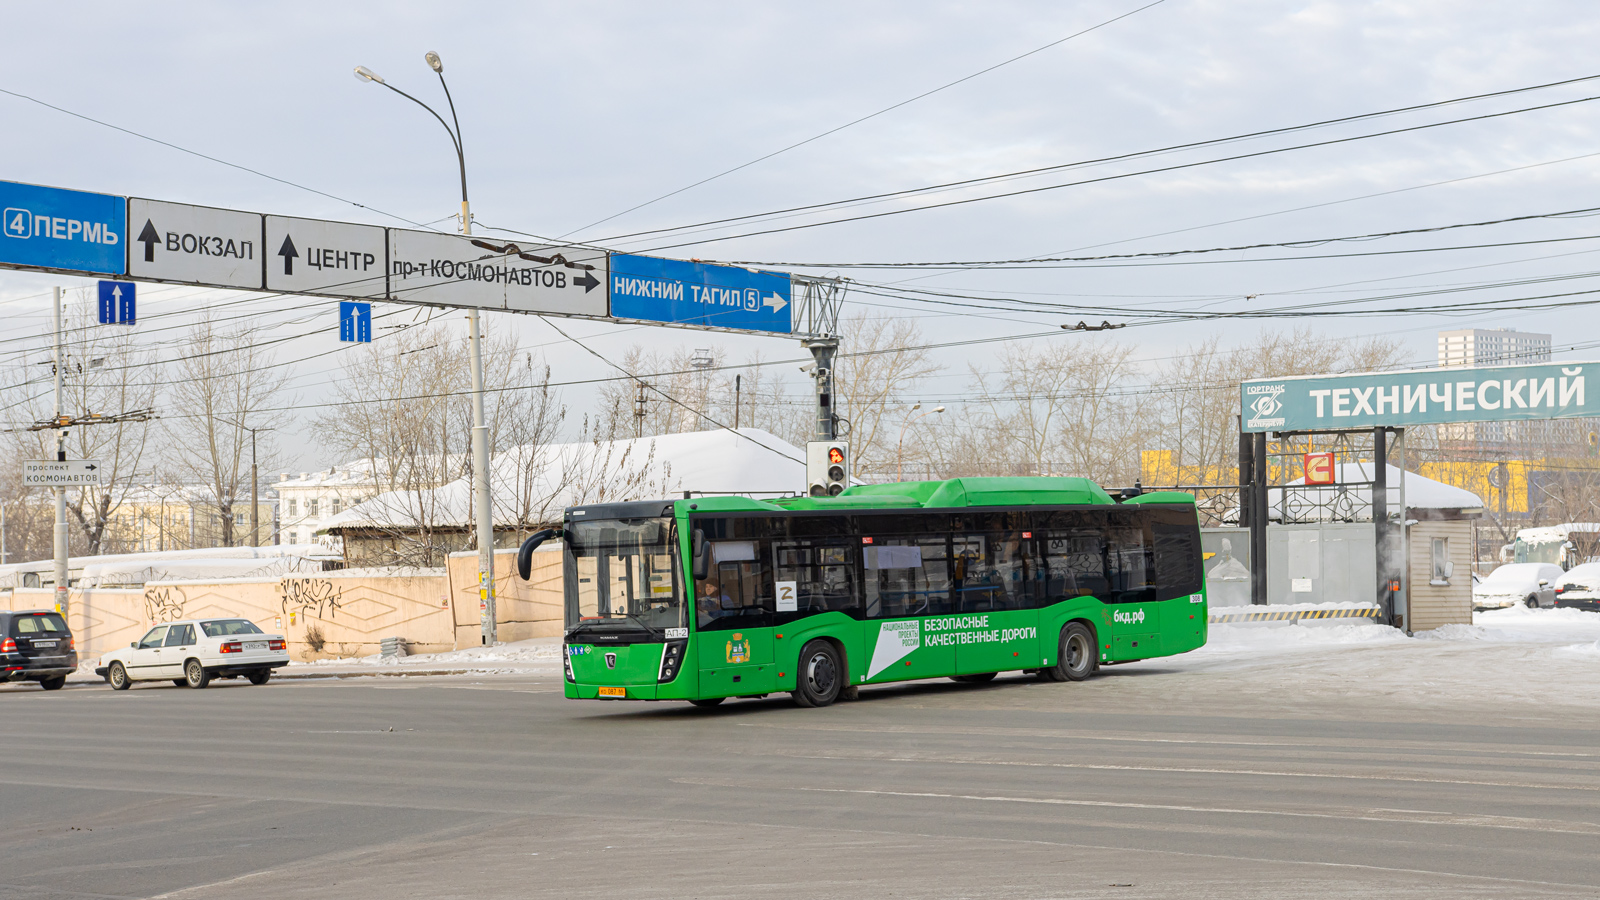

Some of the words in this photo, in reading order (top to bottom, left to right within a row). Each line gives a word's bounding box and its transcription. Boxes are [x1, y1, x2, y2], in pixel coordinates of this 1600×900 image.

[9, 213, 26, 236] 4
[34, 215, 119, 246] ПЕРМЬ
[165, 231, 254, 261] ВОКЗАЛ
[307, 247, 376, 272] ЦЕНТР
[392, 259, 427, 277] пр-т
[430, 258, 567, 289] КОСМОНАВТОВ
[614, 276, 685, 302] НИЖНИЙ
[690, 284, 742, 308] ТАГИЛ
[1247, 384, 1286, 395] ГОРТРАНС
[1309, 366, 1586, 418] ТЕХНИЧЕСКИЙ
[27, 464, 70, 472] проспект
[26, 474, 98, 483] КОСМОНАВТОВ
[924, 616, 989, 631] БЕЗОПАСНЫЕ
[1113, 608, 1145, 624] бкд.рф
[665, 629, 687, 638] АП-2
[882, 622, 919, 631] НАЦИОНАЛЬНЫЕ
[898, 631, 919, 639] ПРОЕКТЫ
[901, 638, 919, 647] РОССИИ
[924, 630, 999, 647] КАЧЕСТВЕННЫЕ
[1001, 627, 1037, 643] ДОРОГИ
